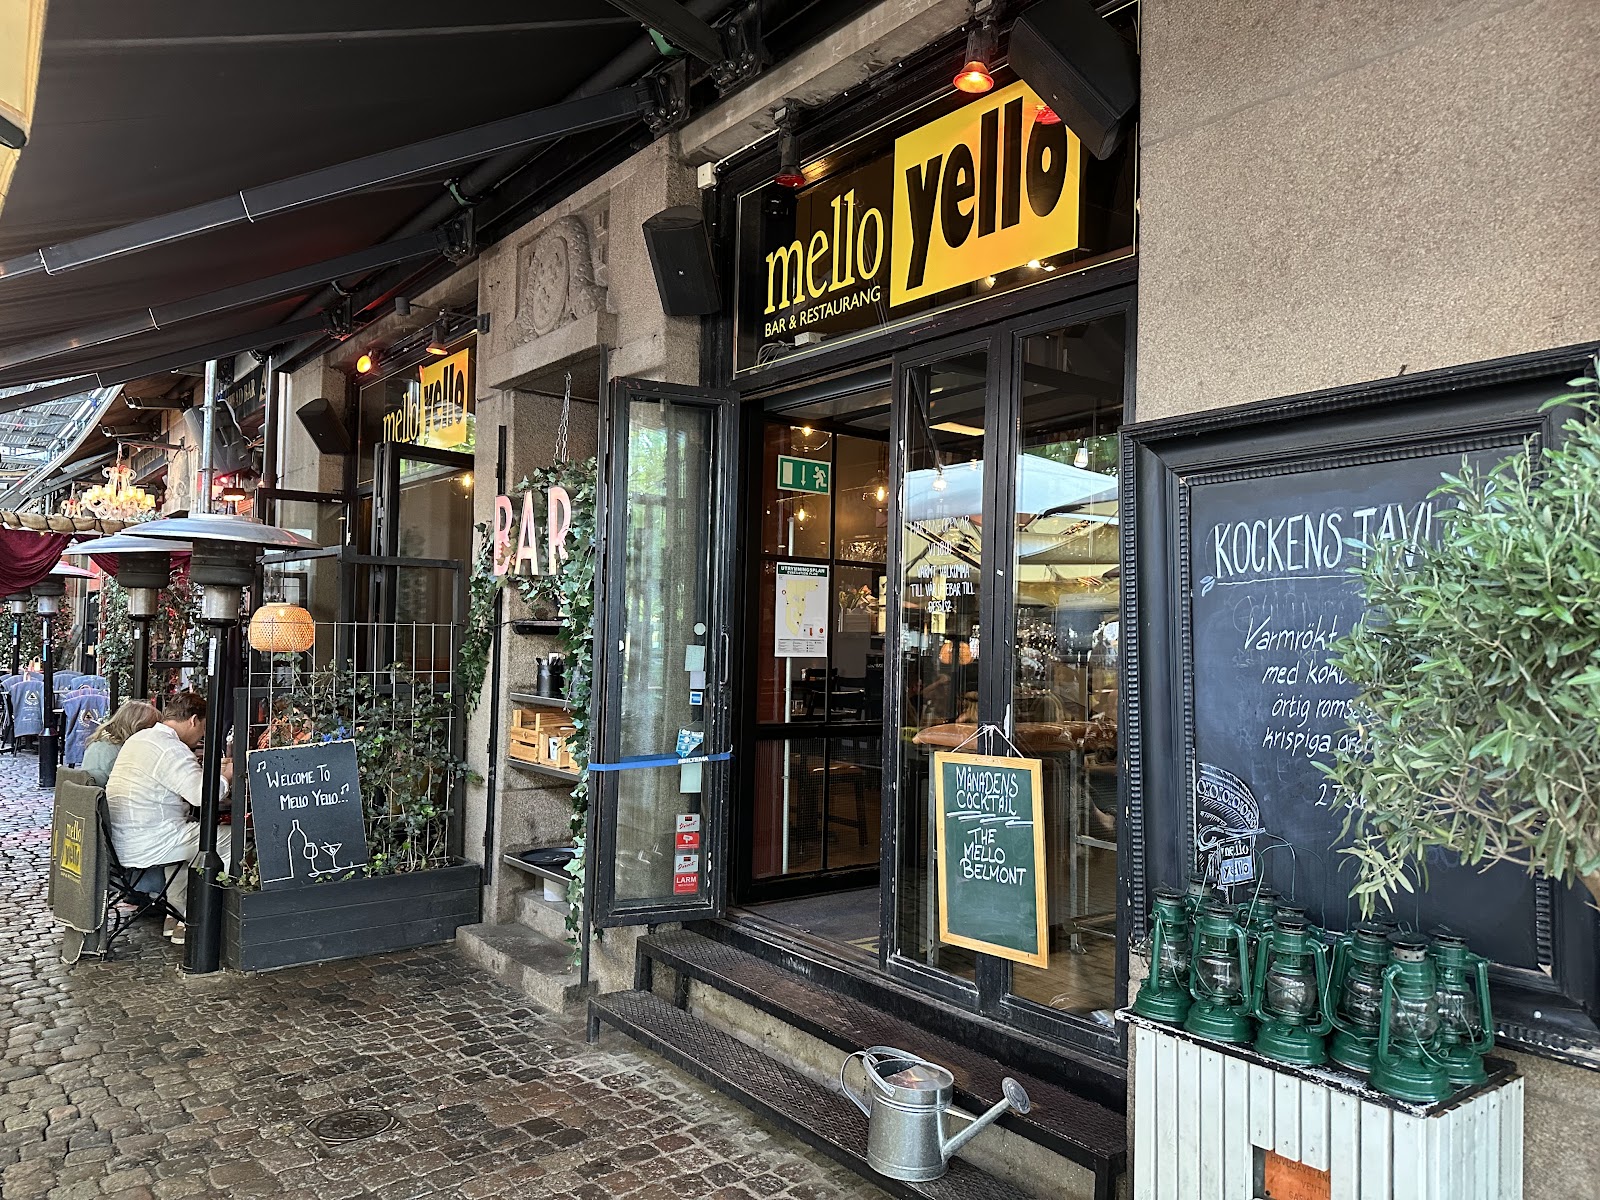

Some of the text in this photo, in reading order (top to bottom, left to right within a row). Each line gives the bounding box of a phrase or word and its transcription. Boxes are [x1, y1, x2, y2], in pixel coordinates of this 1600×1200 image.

[764, 96, 1068, 314] mello yello
[765, 285, 881, 337] BAR & RESTAURANG
[383, 362, 465, 446] mello yello
[493, 486, 571, 576] BAR
[1215, 512, 1343, 578] KOCKENS
[1245, 614, 1338, 651] Varmrökt
[1262, 660, 1299, 685] med
[1271, 693, 1311, 728] örtig
[1262, 726, 1332, 758] krispiga
[956, 790, 1017, 816] COCKTAIL
[967, 826, 997, 845] THE
[964, 842, 1006, 865] MELLO
[676, 876, 697, 884] LARM
[959, 858, 1027, 886] BELMONT
